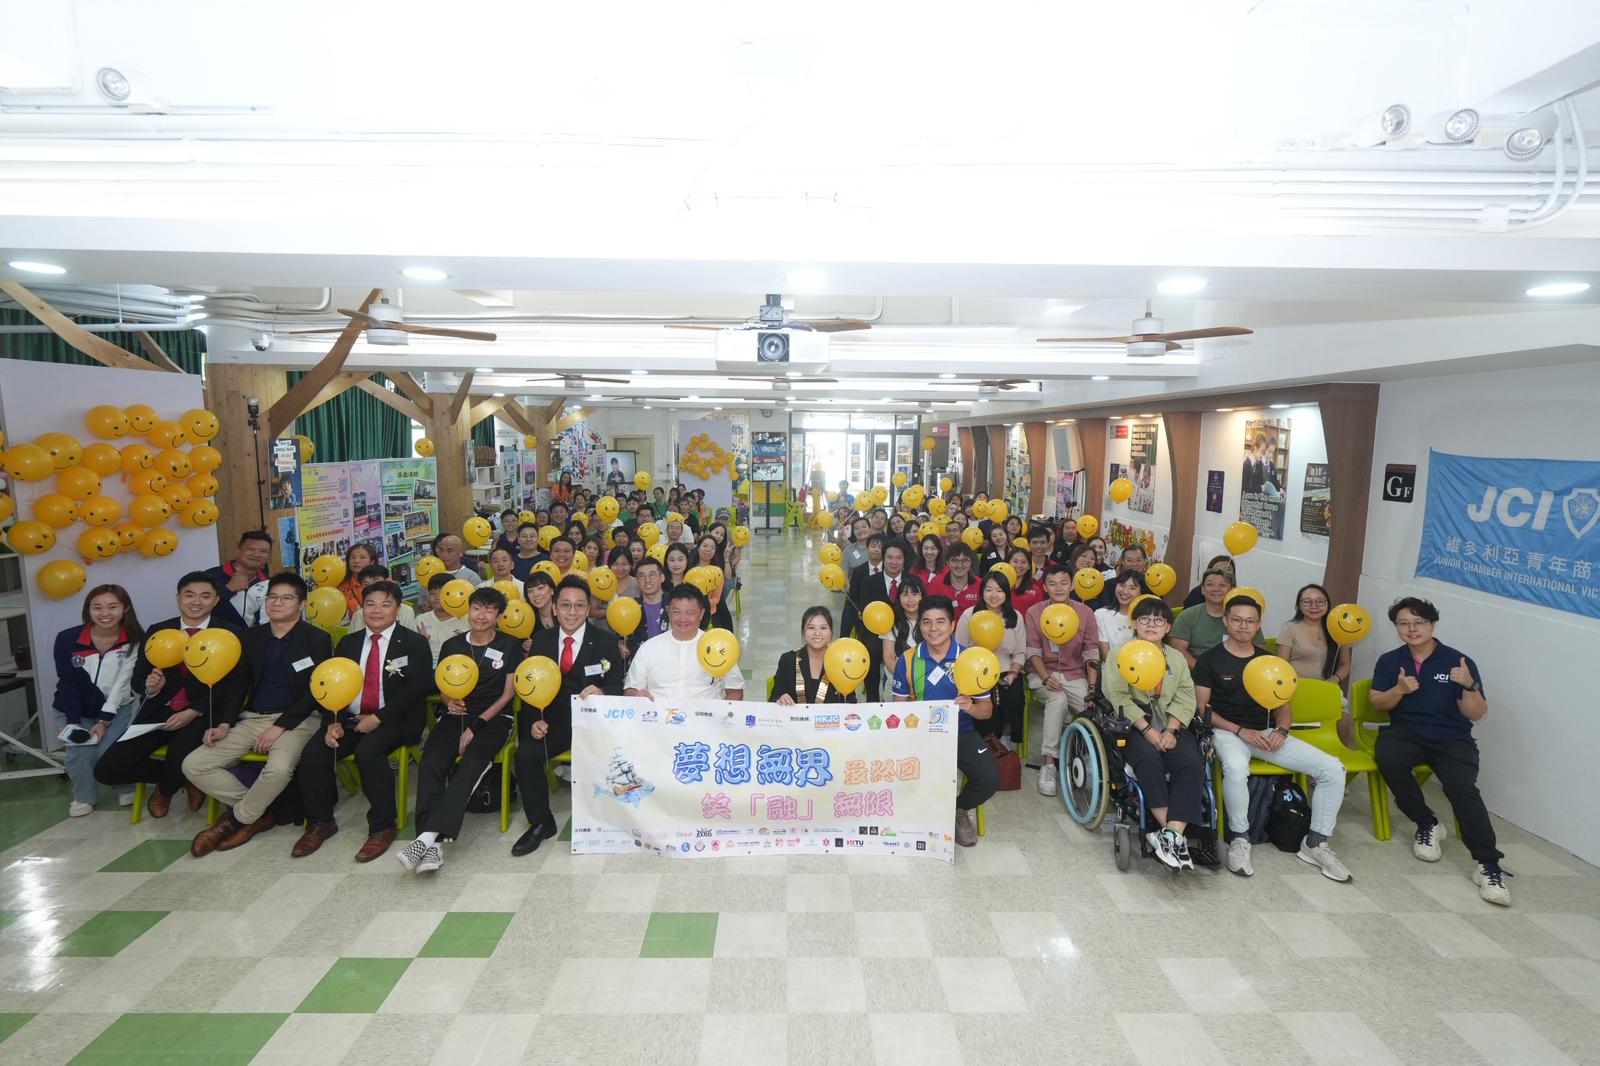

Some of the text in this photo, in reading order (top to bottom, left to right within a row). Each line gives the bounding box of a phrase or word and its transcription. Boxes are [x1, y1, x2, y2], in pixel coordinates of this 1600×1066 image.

[1467, 485, 1554, 530] JCI
[1434, 555, 1600, 599] JUNIOR CHAMBER INTERNATIONAL VIC
[1446, 536, 1600, 579] 維多利亞青年商
[1434, 673, 1449, 681] JCI
[604, 709, 625, 719] JCI
[673, 741, 921, 787] 夢想無界 最終回
